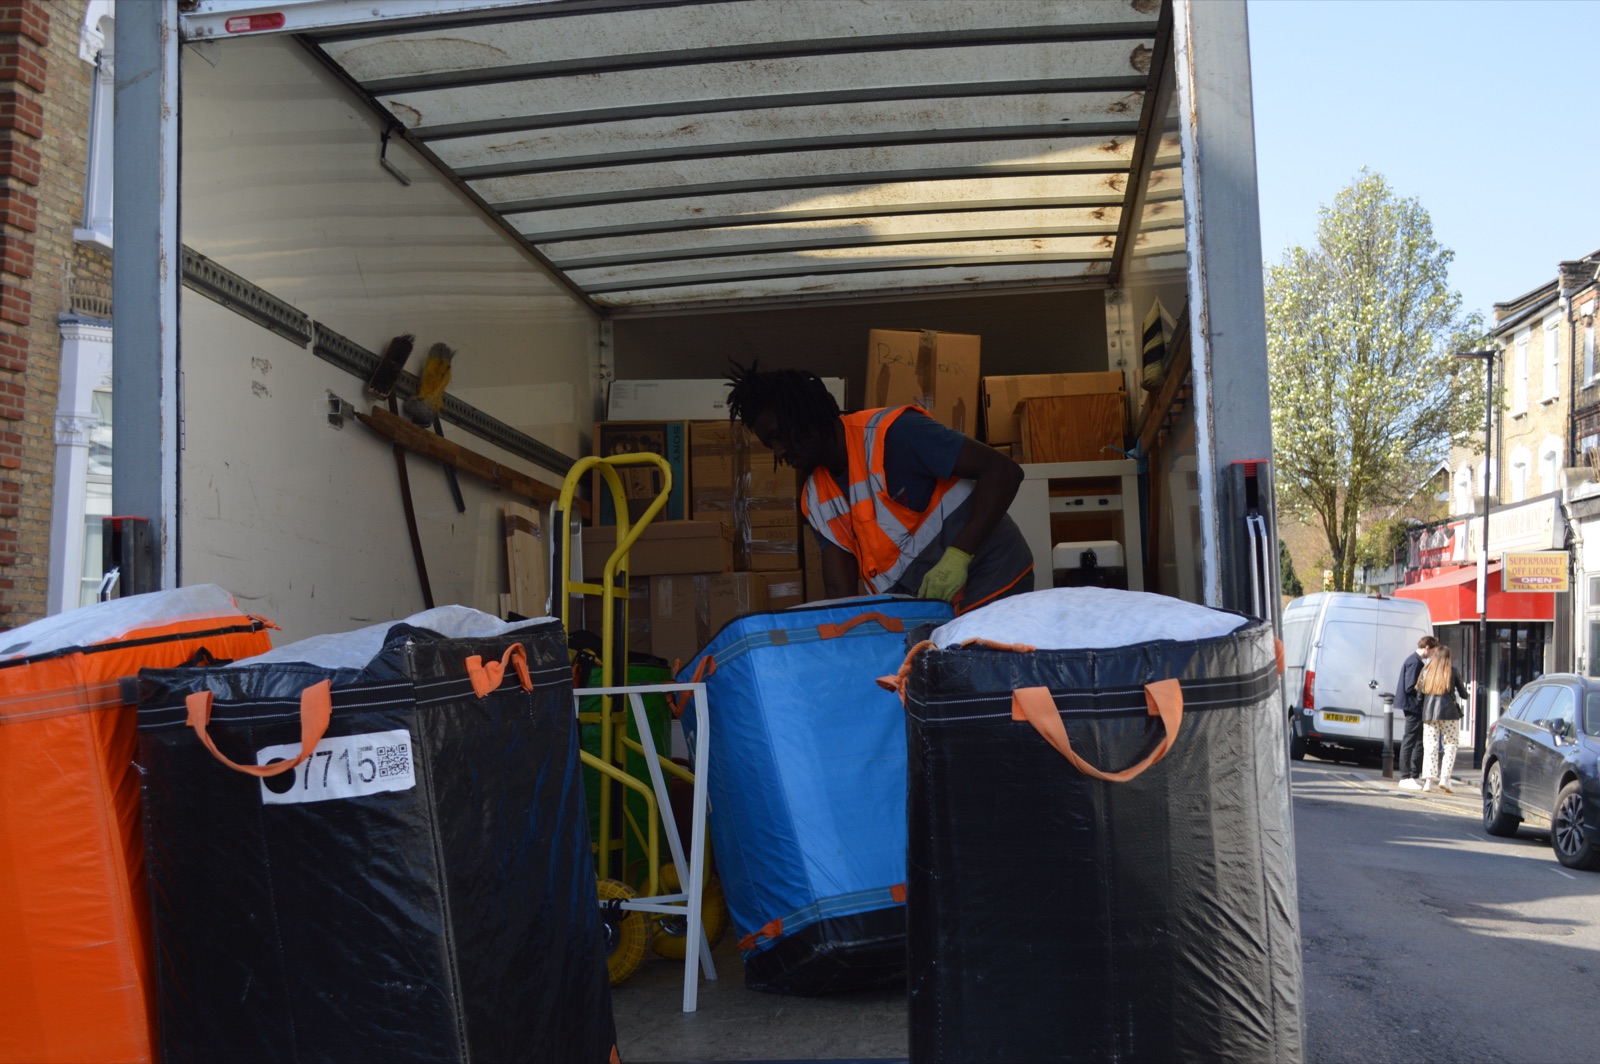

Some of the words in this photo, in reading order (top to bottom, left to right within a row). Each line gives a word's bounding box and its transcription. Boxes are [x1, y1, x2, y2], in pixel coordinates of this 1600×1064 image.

[673, 425, 681, 464] SONY
[1509, 556, 1563, 565] SUPERMARKET
[1511, 567, 1526, 575] OFF
[1528, 567, 1560, 576] LICENCE
